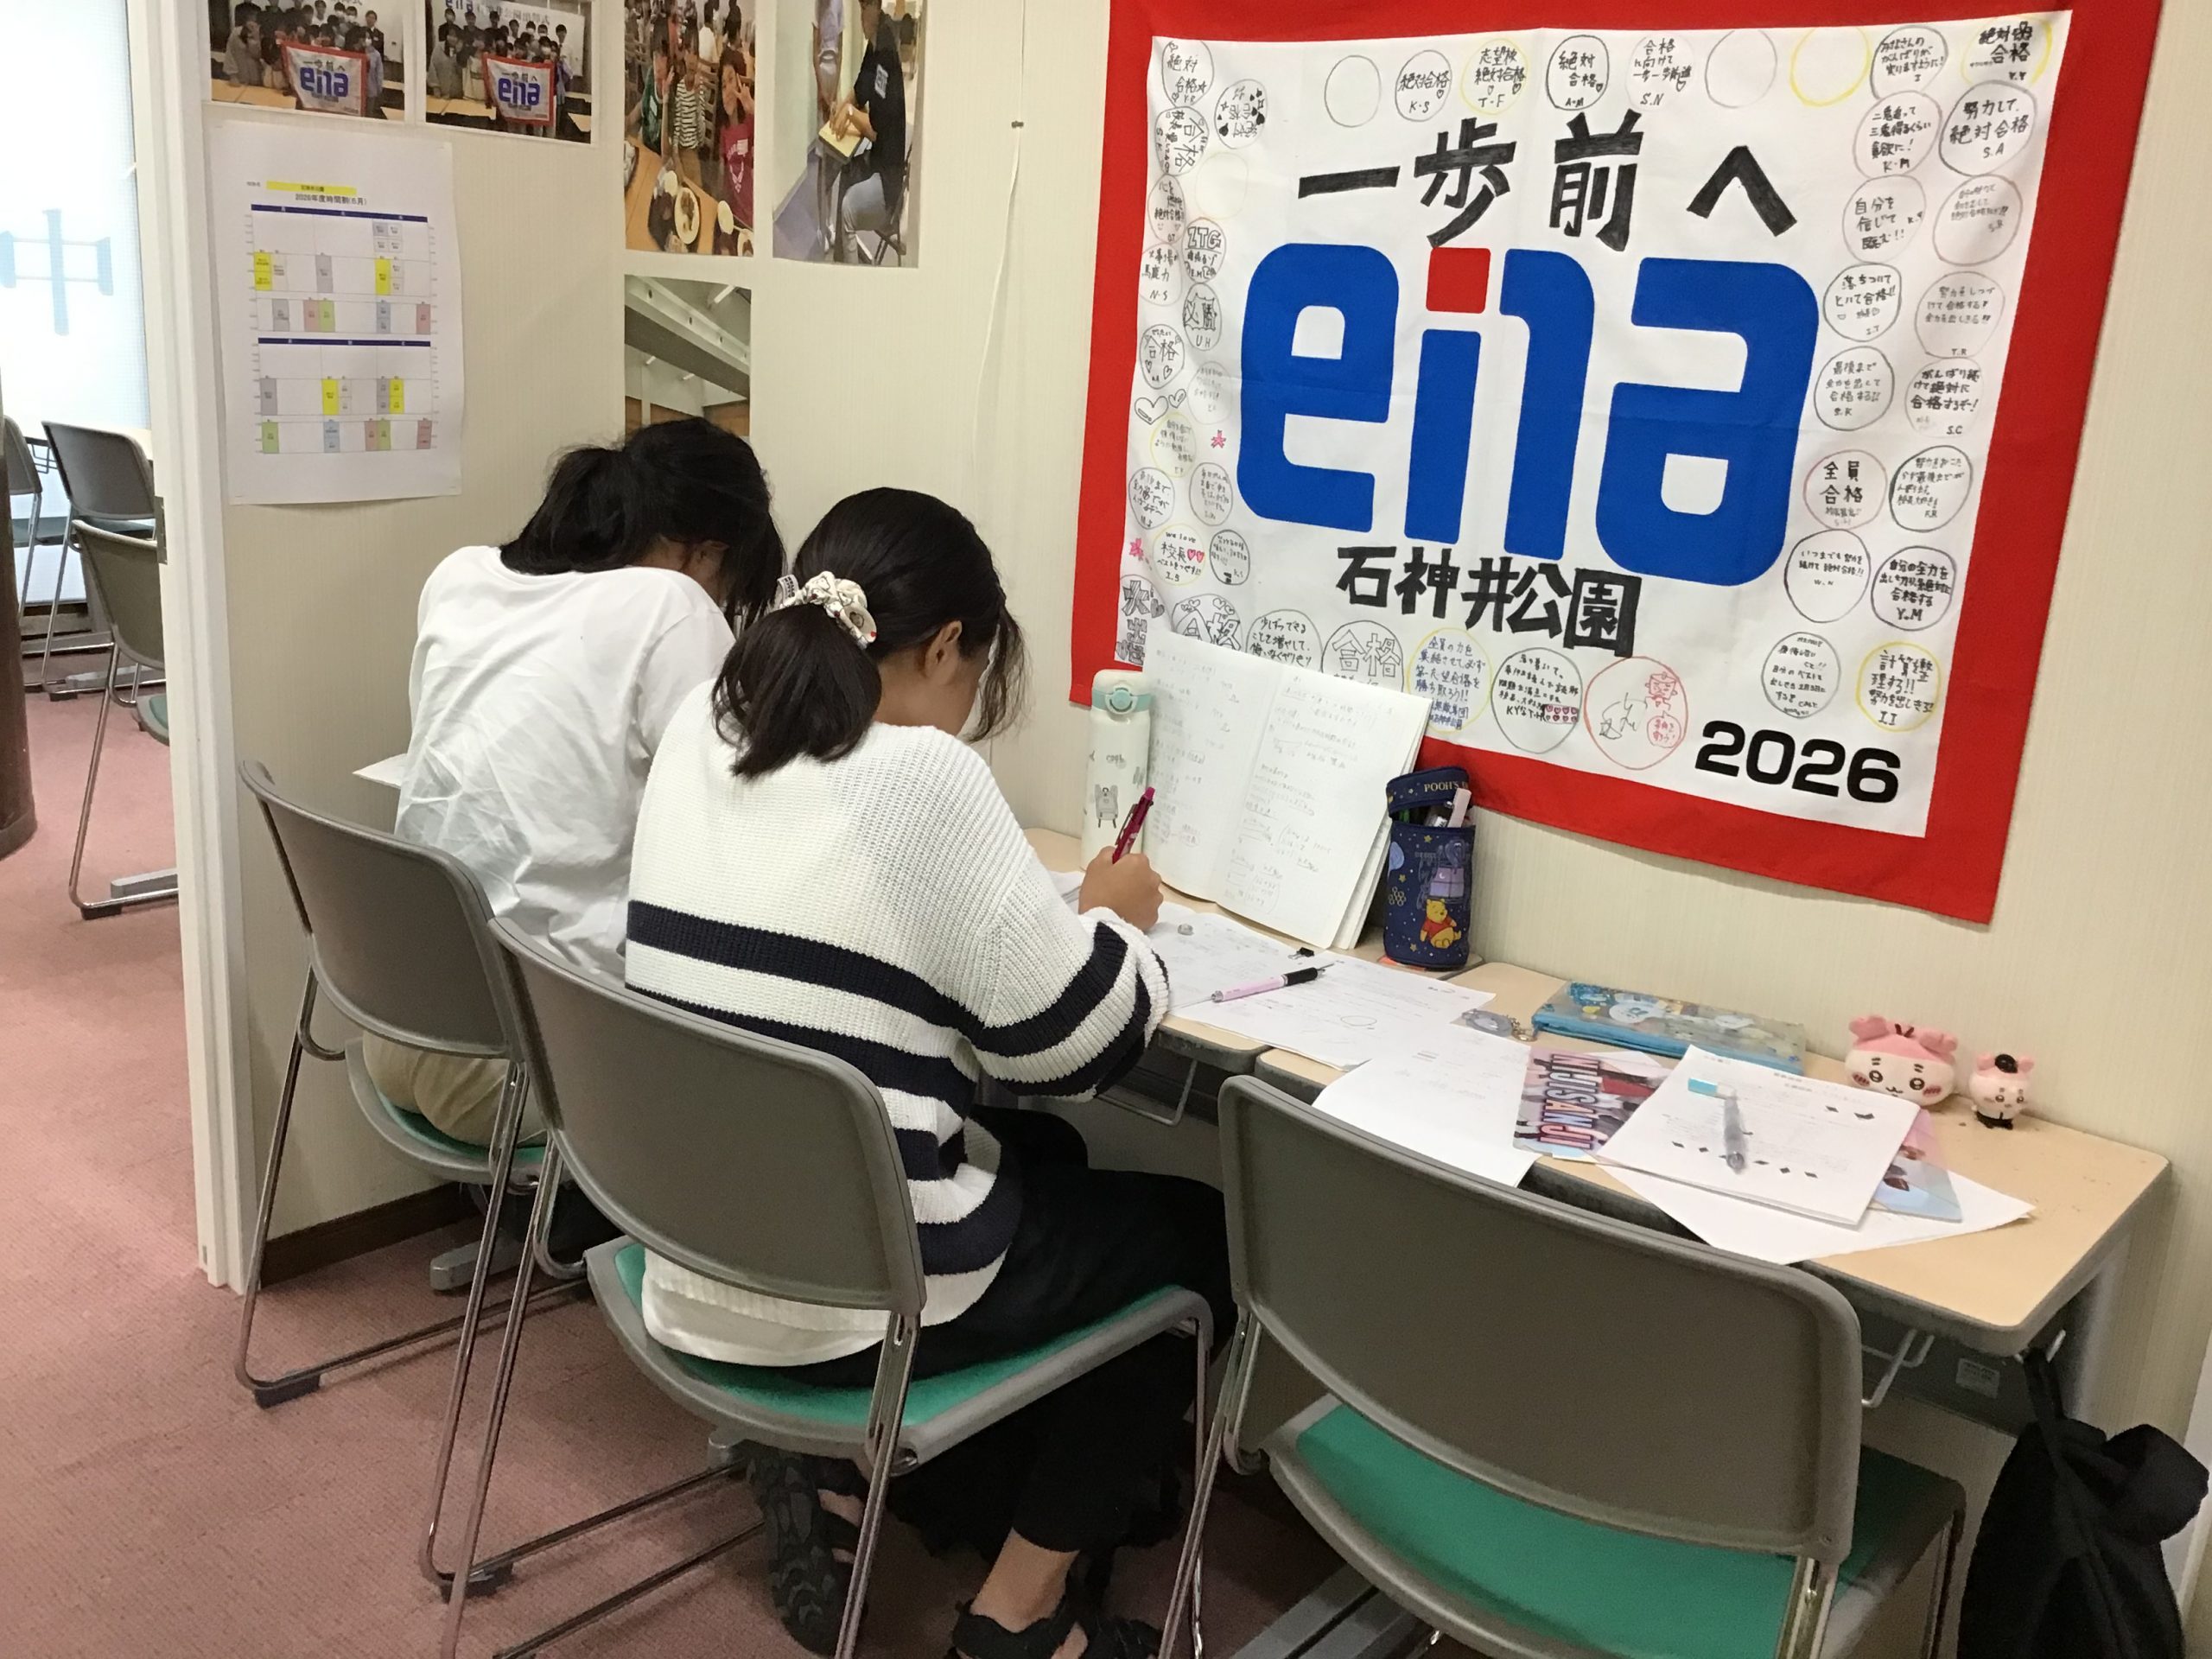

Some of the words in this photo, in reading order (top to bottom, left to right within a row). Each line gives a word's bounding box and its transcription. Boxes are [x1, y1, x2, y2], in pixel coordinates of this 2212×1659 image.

[1643, 37, 1675, 55] 合格
[1991, 41, 2031, 64] 合格
[1558, 50, 1596, 71] 絶対
[1397, 70, 1451, 92] 絶対合格
[1474, 66, 1526, 84] 絶対合格
[1568, 73, 1597, 87] 合格
[1949, 114, 2029, 145] 絶対合格
[1298, 109, 1798, 251] 一歩前へ
[1854, 197, 1894, 215] 自分を
[1858, 214, 1897, 232] 信じて
[1236, 243, 1820, 588] ena
[1823, 460, 1860, 482] 全員
[1819, 484, 1864, 505] 合格
[1335, 547, 1642, 657] 石神井公園
[1332, 629, 1402, 678] 合格
[1694, 720, 1901, 804] 2026
[1537, 1052, 1603, 1150] NIJISANJI
